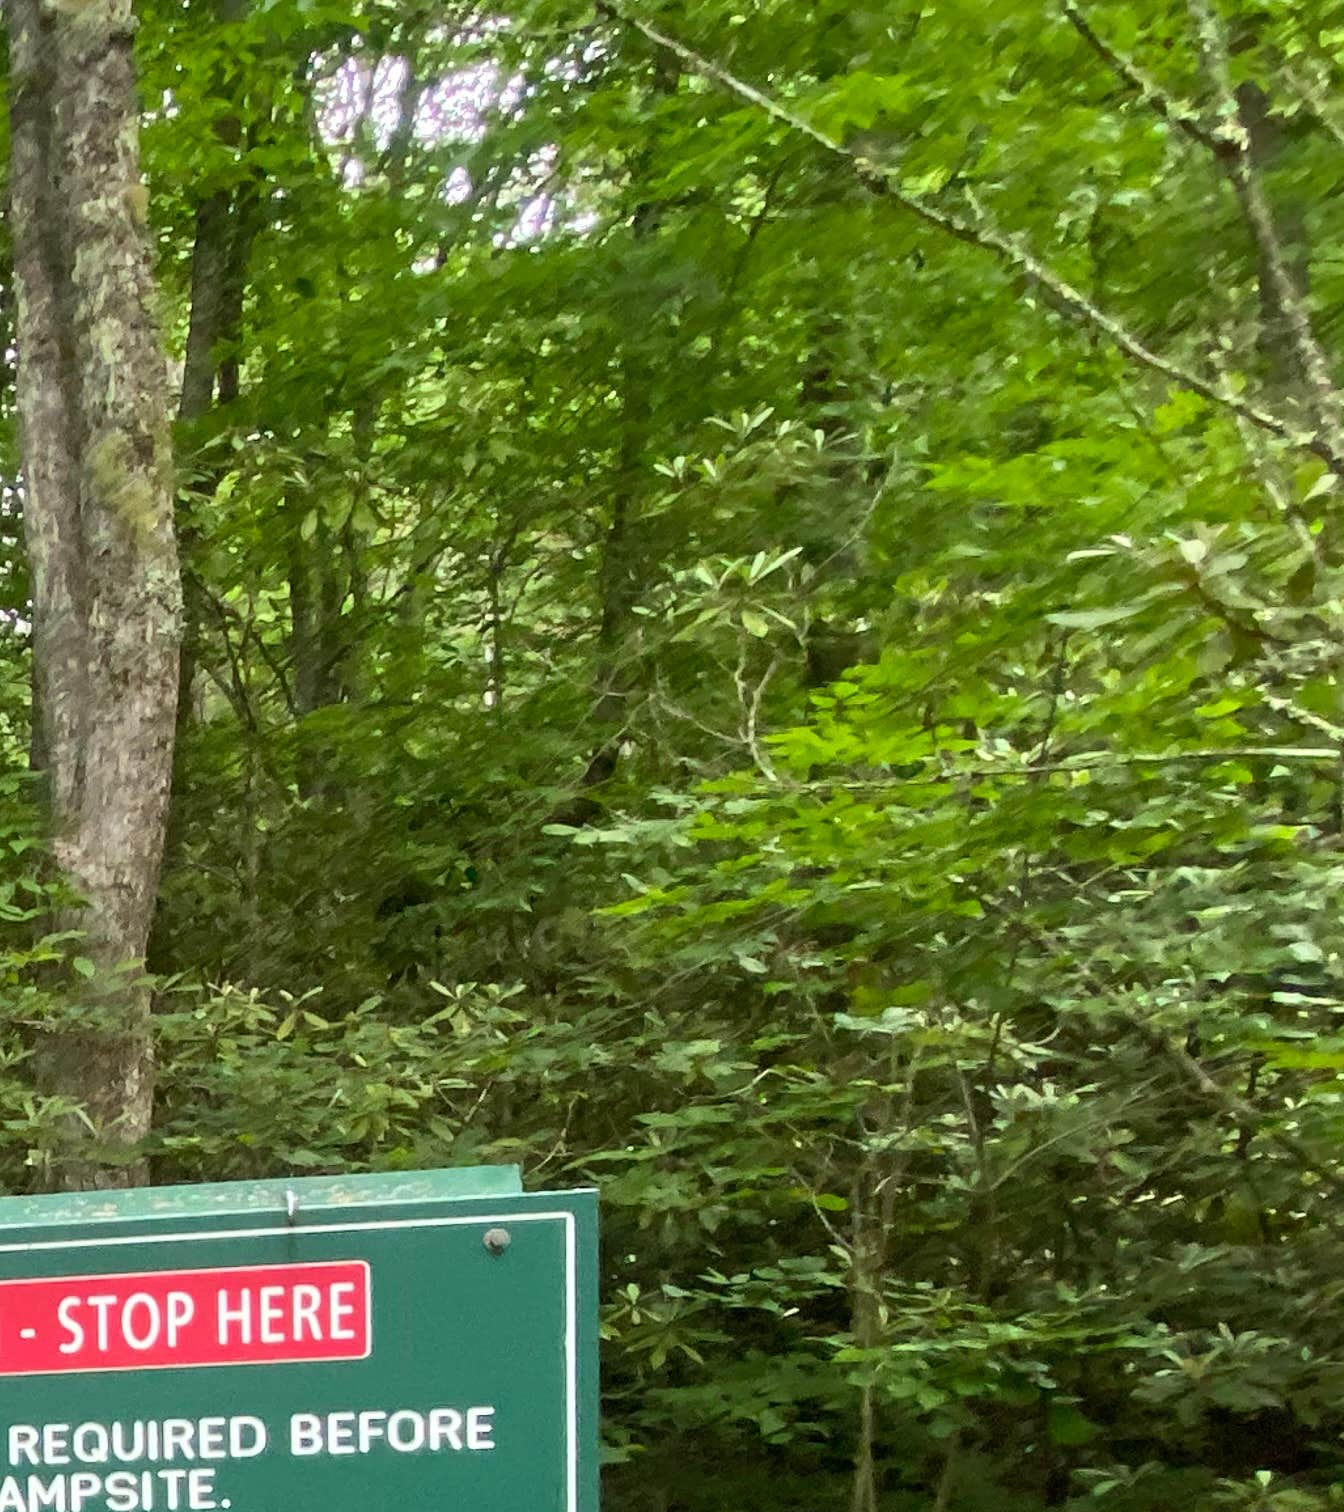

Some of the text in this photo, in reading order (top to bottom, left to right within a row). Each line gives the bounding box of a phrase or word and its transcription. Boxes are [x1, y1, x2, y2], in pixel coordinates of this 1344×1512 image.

[19, 1327, 37, 1341] -
[57, 1291, 195, 1354] STOP
[217, 1282, 355, 1346] HERE
[8, 1415, 267, 1466] REQUIRED
[290, 1406, 496, 1456] BEFORE
